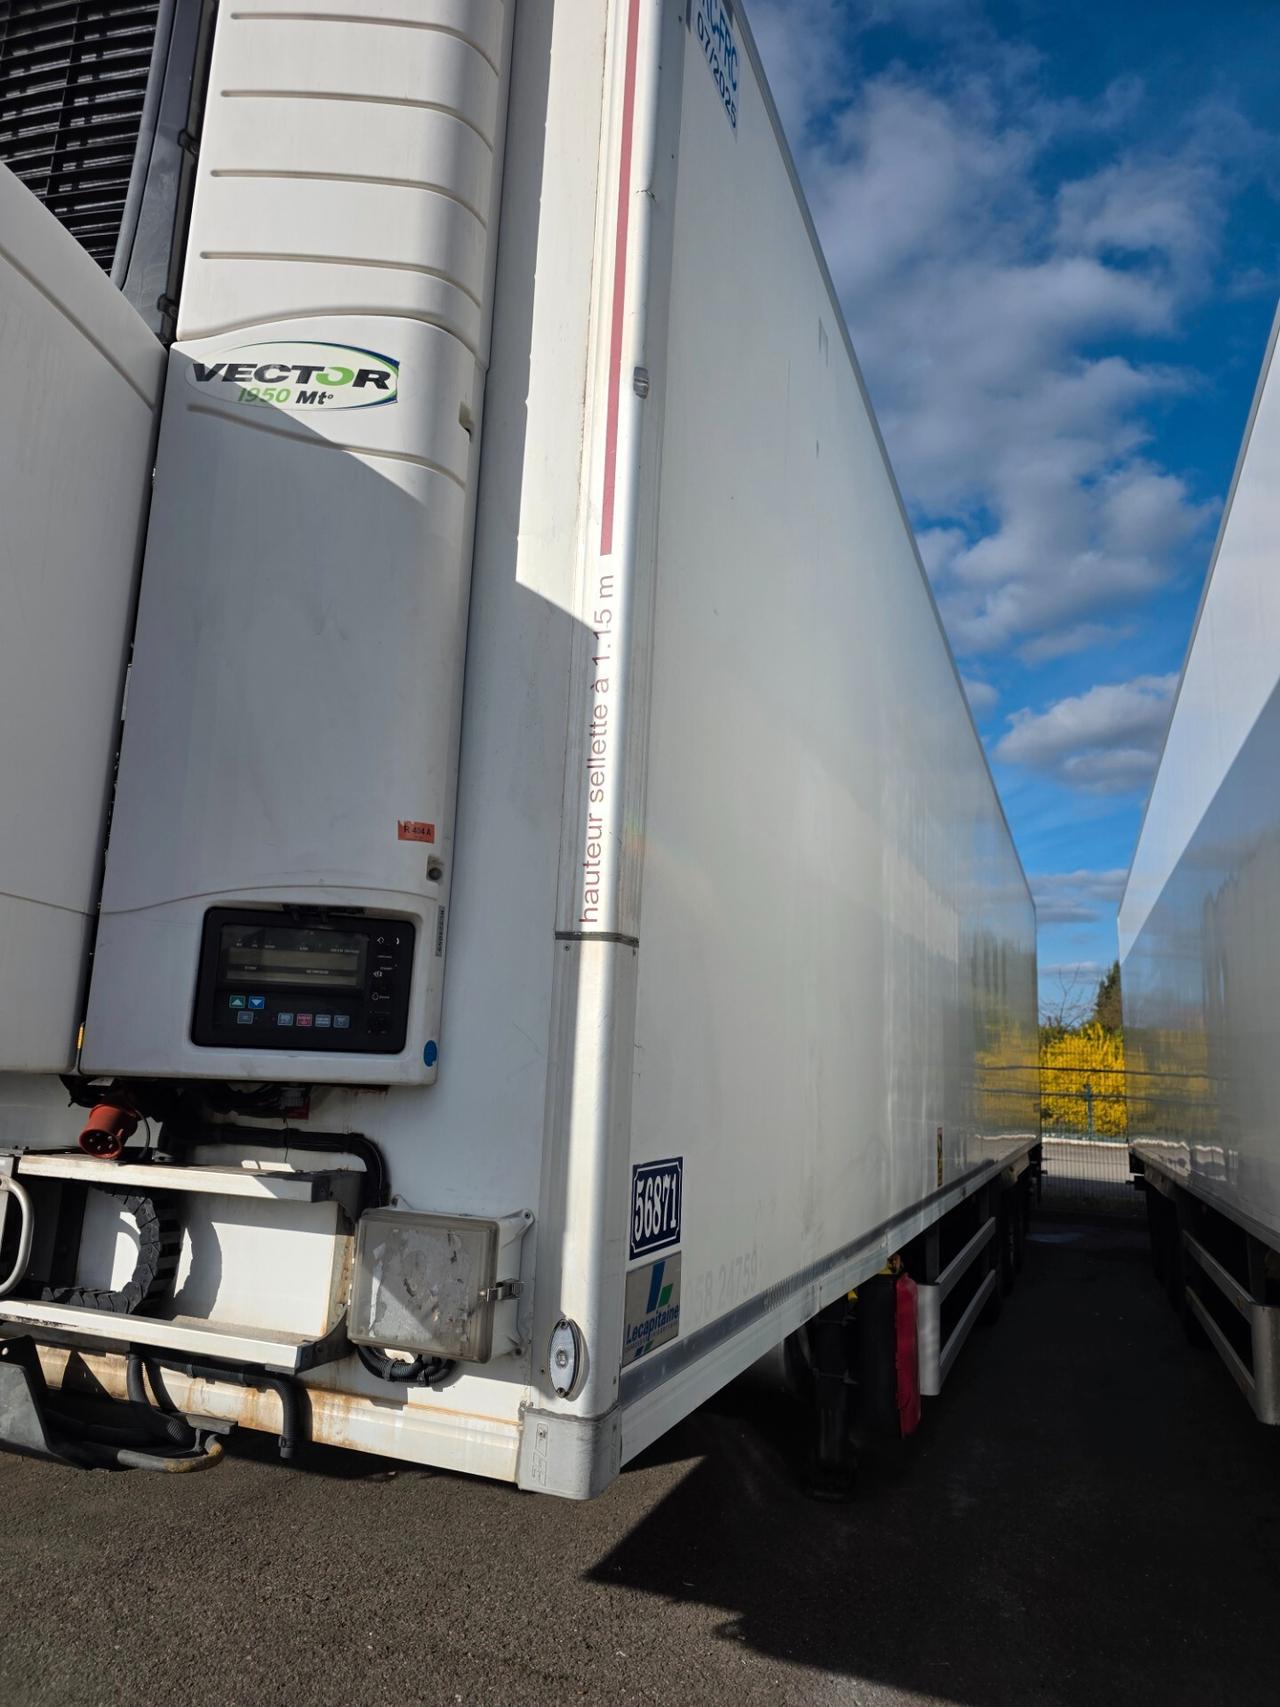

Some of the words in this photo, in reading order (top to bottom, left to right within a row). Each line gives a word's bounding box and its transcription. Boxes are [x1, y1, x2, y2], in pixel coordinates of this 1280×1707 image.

[697, 11, 737, 128] 07/2025
[193, 363, 392, 390] VECTOR
[238, 387, 291, 403] 1950
[599, 574, 614, 599] m
[591, 608, 613, 667] 1.15
[590, 678, 609, 694] à
[586, 704, 608, 802] sellette
[579, 812, 603, 923] hauteur
[634, 1173, 678, 1242] 56871
[624, 1303, 680, 1345] Lecapitaine
